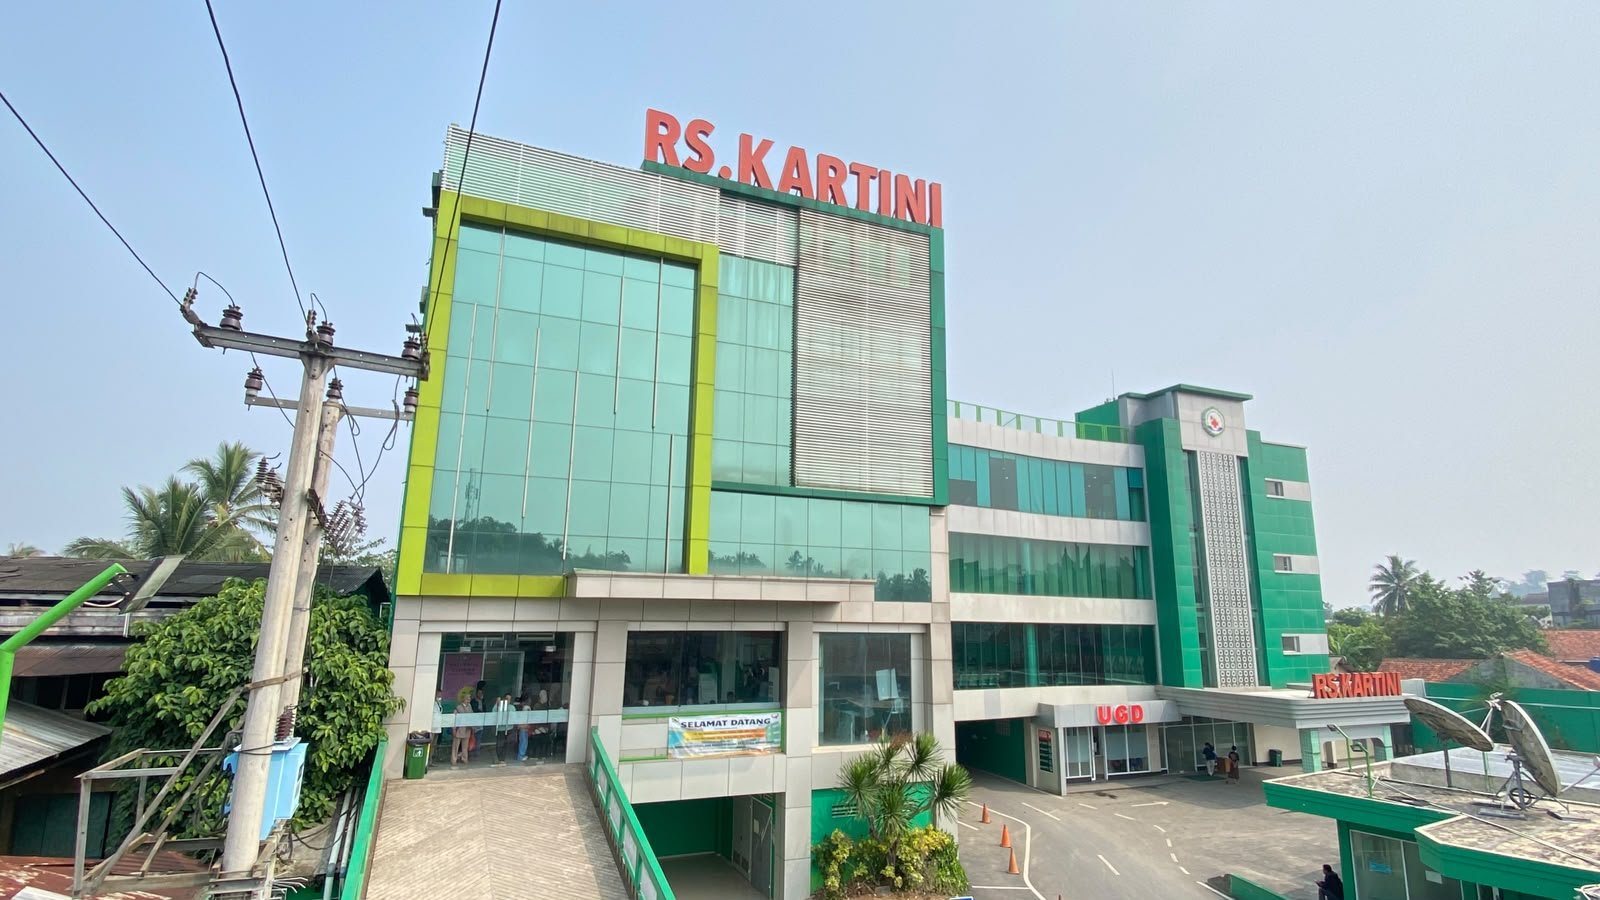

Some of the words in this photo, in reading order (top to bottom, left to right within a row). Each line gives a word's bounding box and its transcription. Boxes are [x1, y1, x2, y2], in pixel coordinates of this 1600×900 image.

[644, 108, 942, 226] RS.KARTINI
[681, 719, 727, 728] SELAMAT
[731, 718, 771, 726] DATANG
[1097, 704, 1144, 725] UGD
